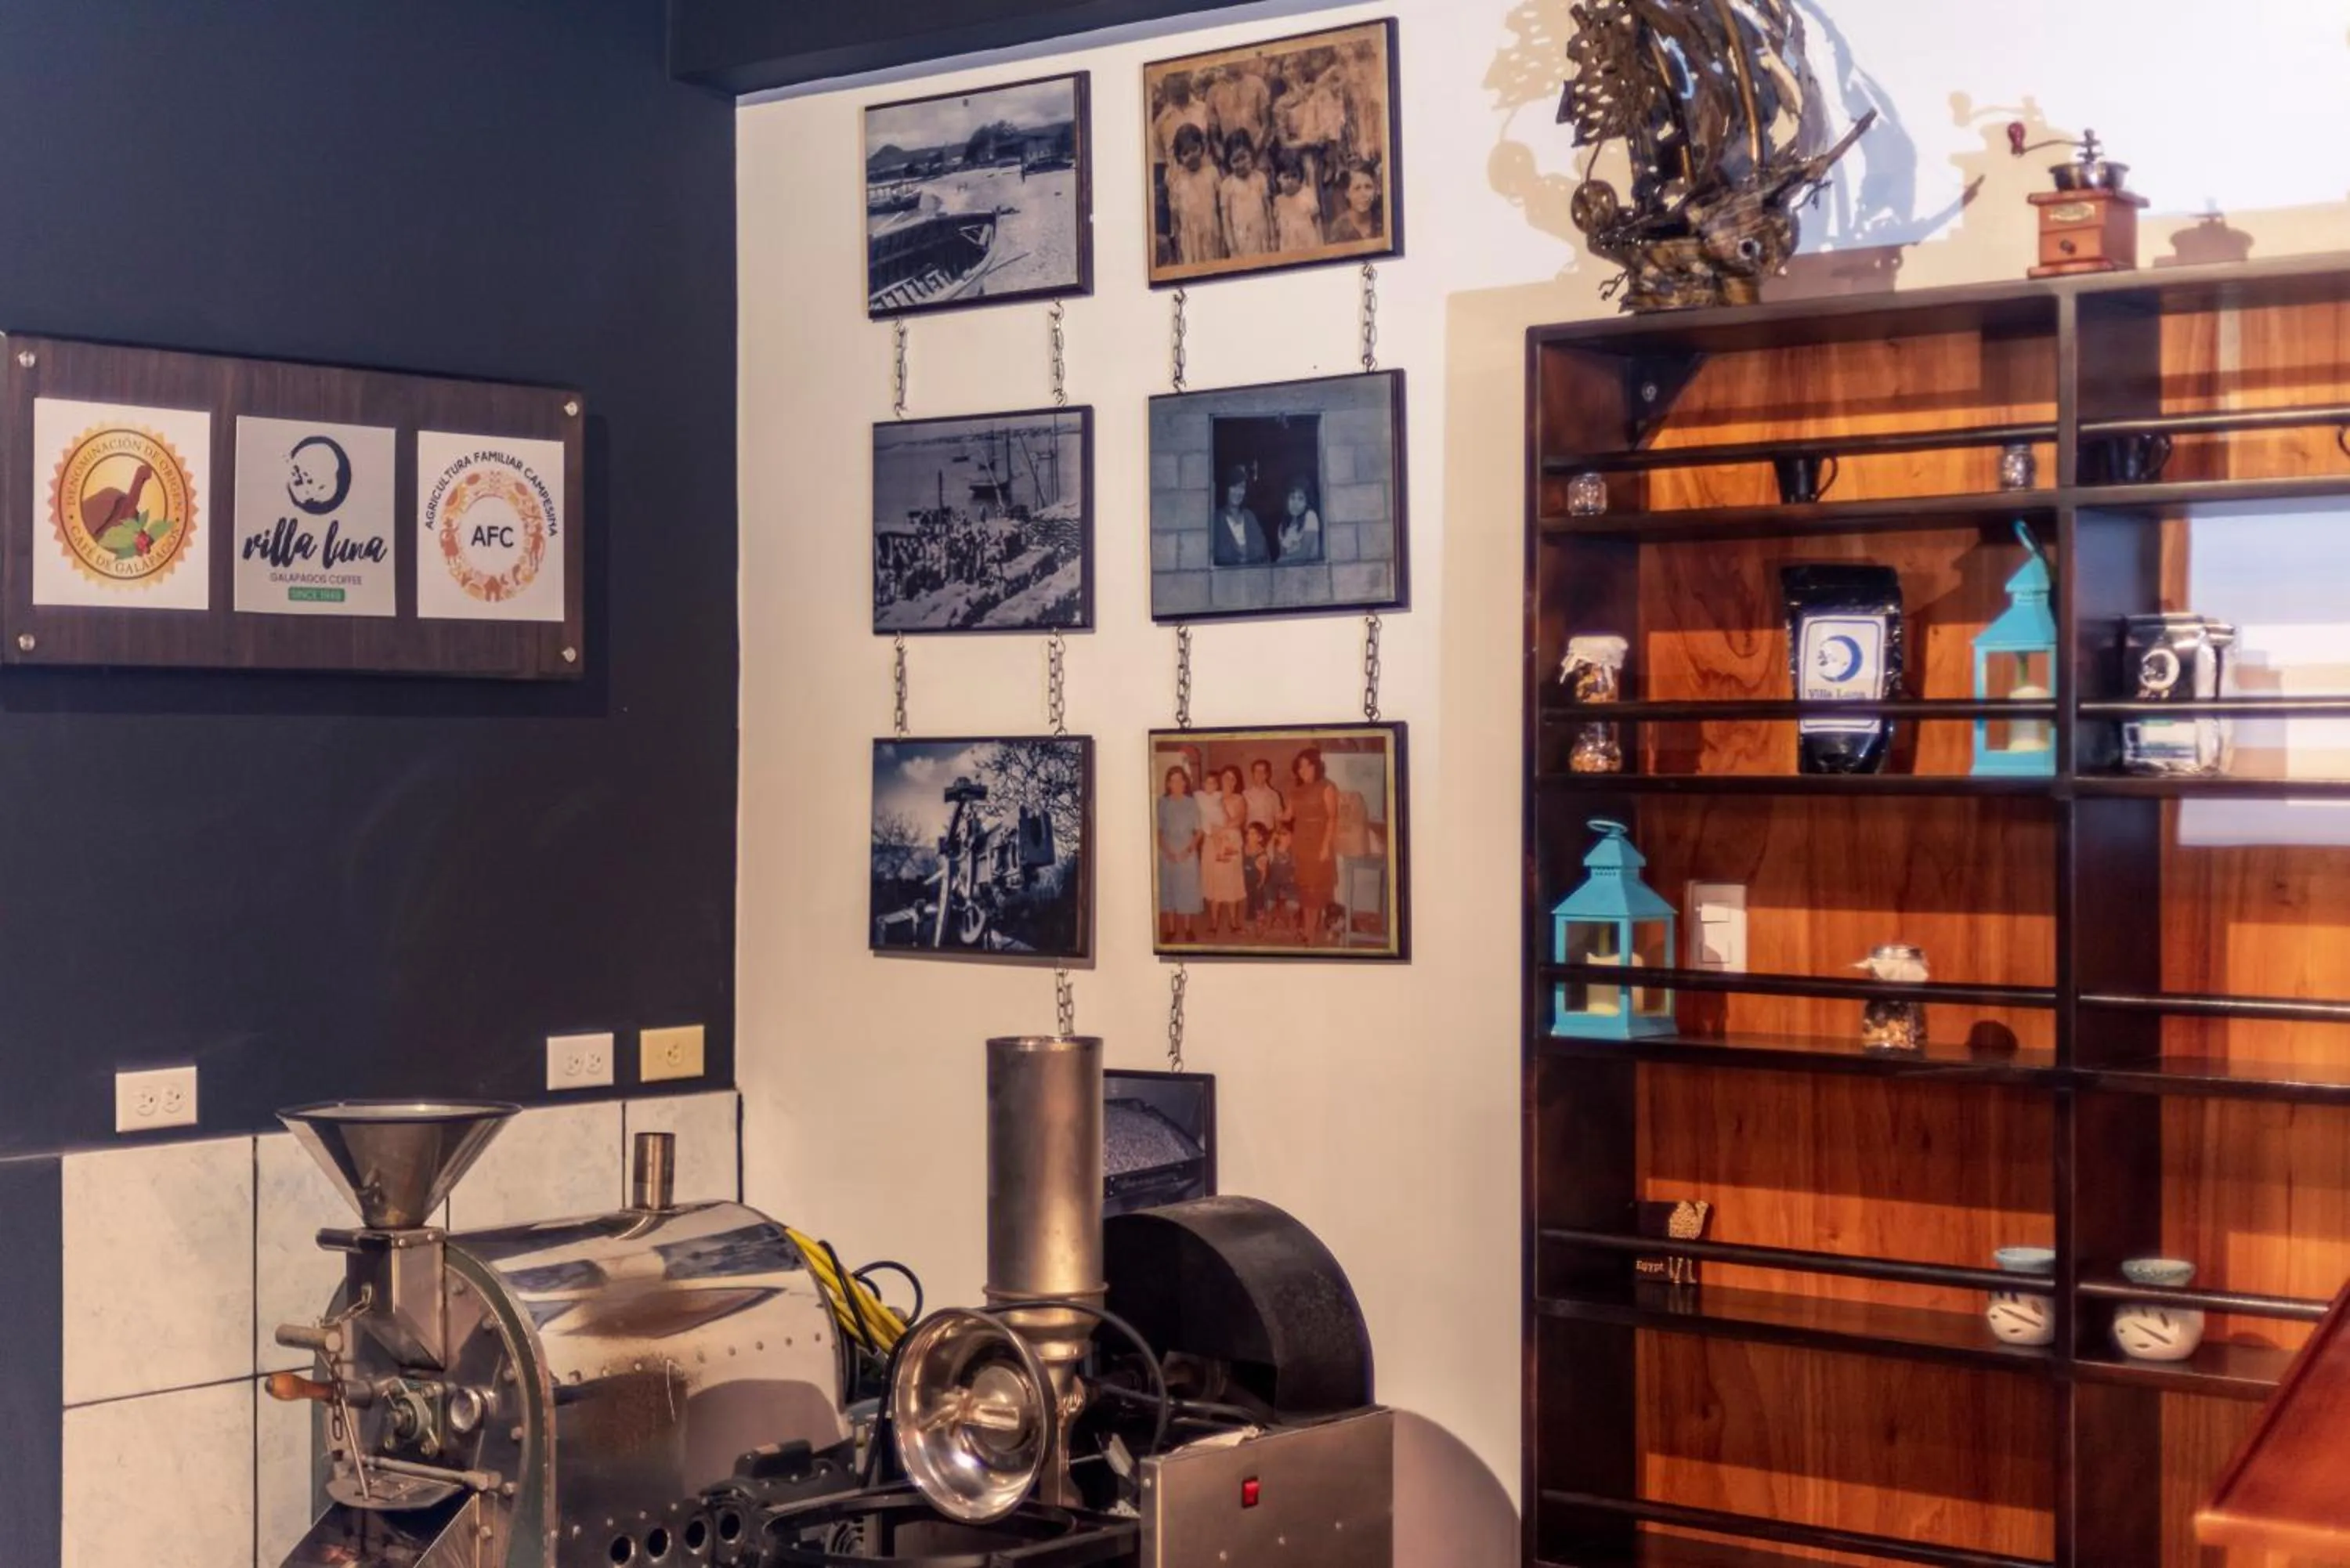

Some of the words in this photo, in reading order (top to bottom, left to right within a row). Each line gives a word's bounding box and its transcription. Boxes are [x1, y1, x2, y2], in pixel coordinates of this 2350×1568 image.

[144, 446, 158, 460] DE
[160, 459, 183, 509] ORIGEN
[425, 456, 472, 530] AGRICULTURA
[474, 451, 523, 471] FAMILIAR
[523, 467, 558, 537] CAMPESINA
[242, 517, 317, 568] villa
[322, 519, 388, 569] luna
[471, 526, 514, 548] AFC
[96, 555, 111, 570] DE
[269, 573, 327, 584] GALAPAGOS
[329, 575, 362, 586] COFFEE
